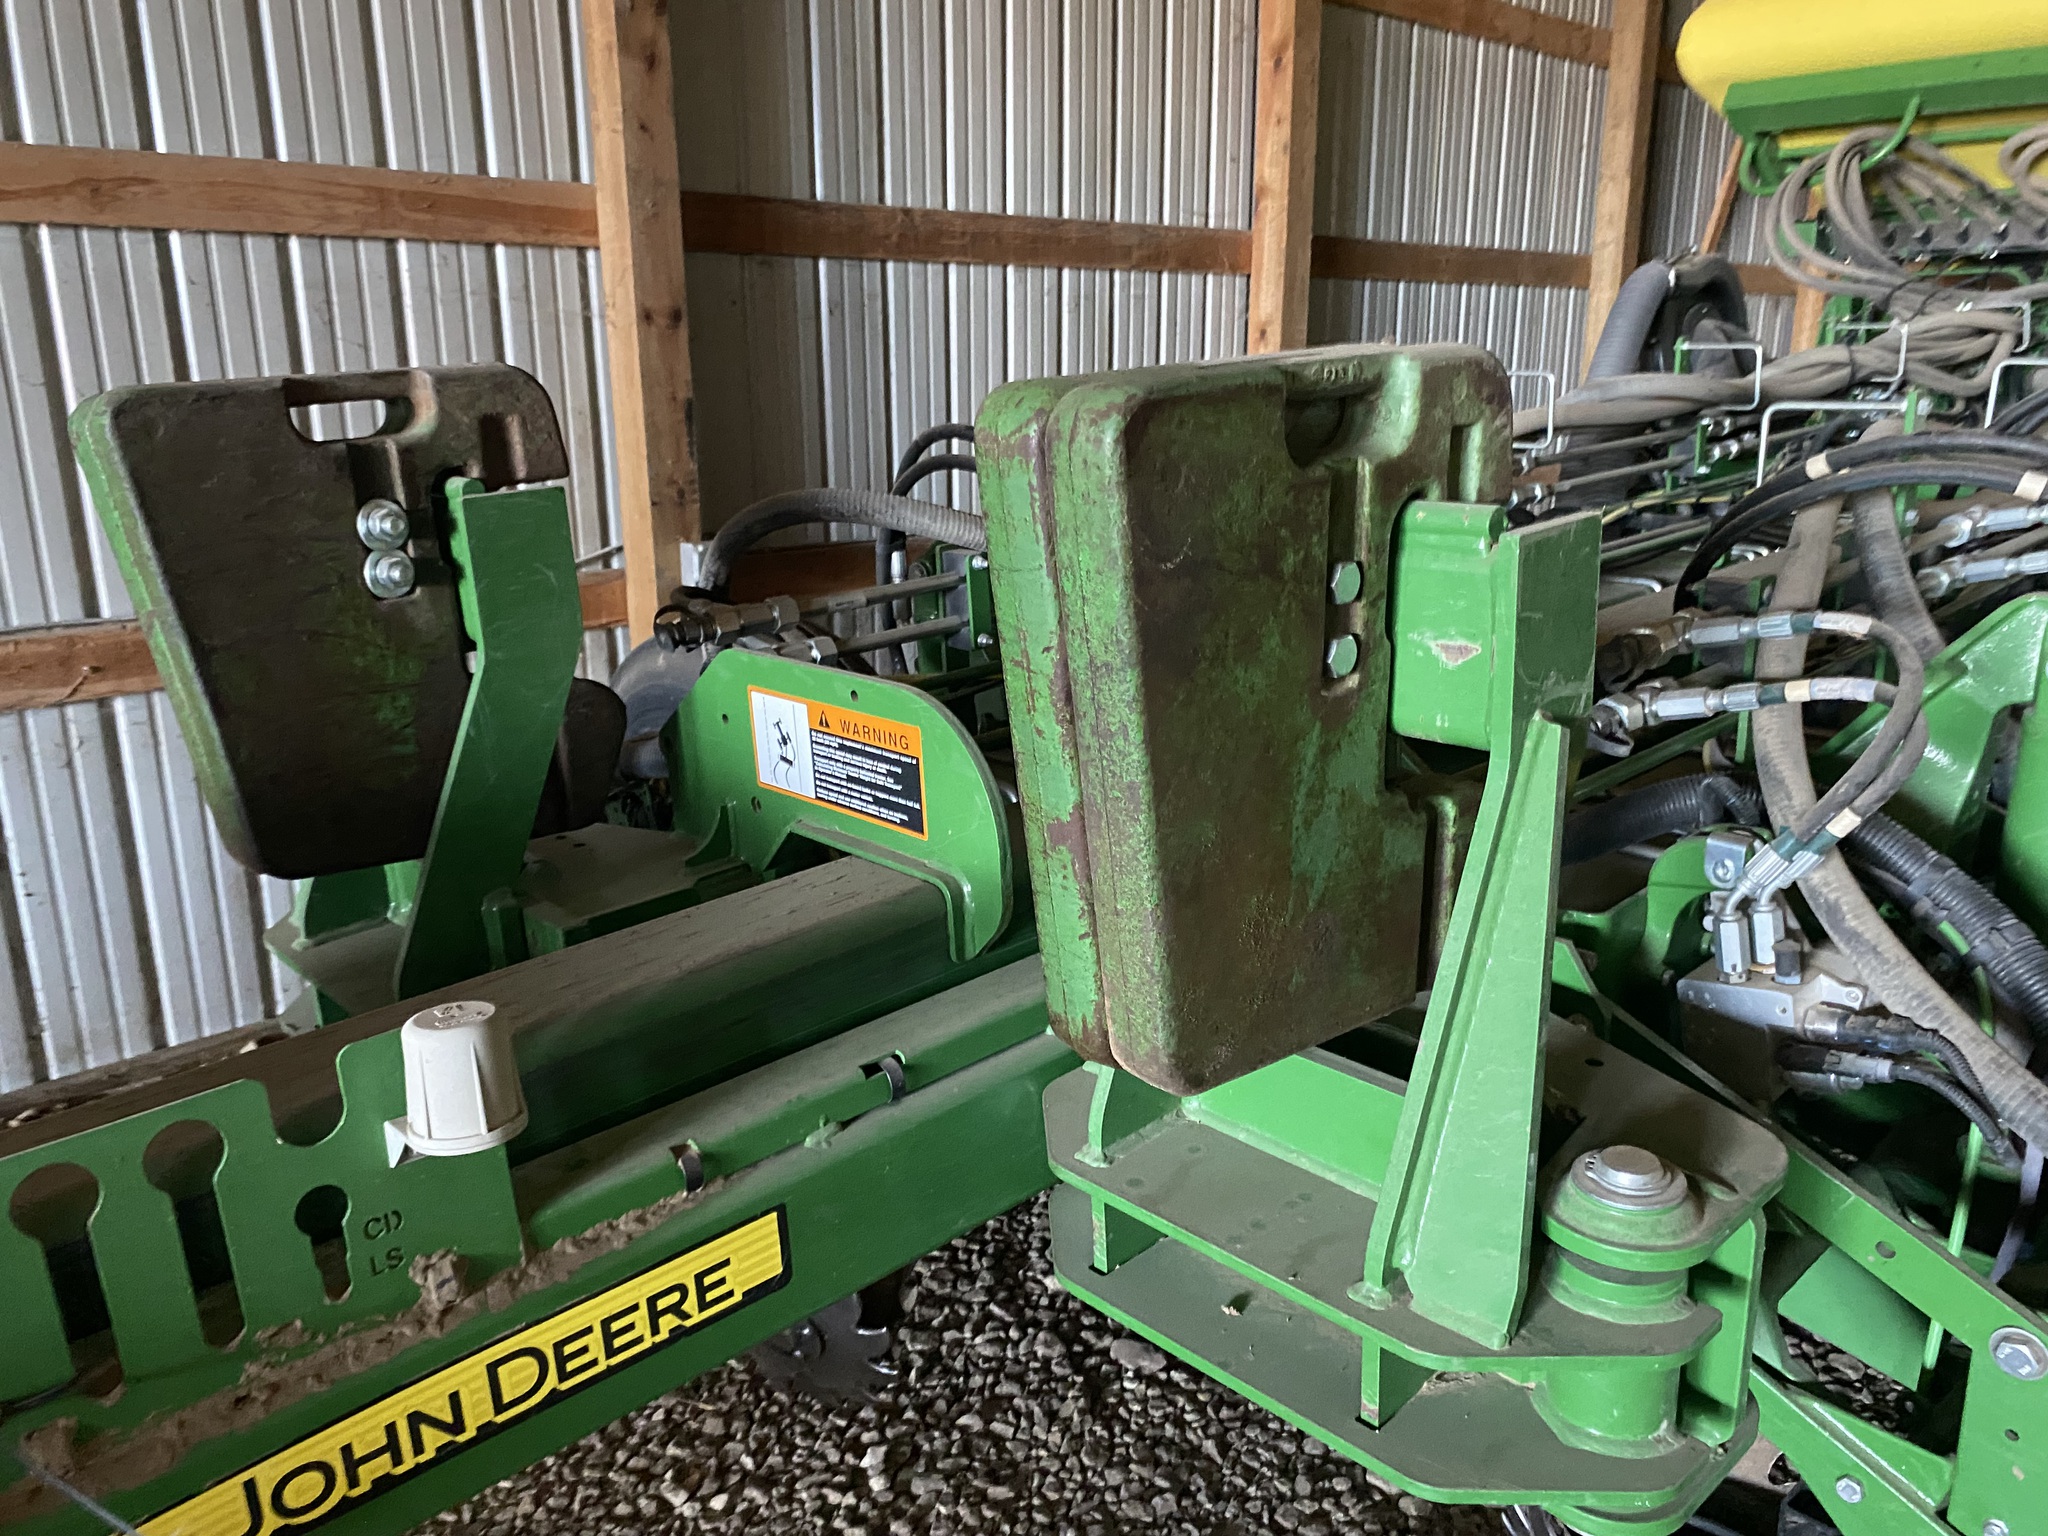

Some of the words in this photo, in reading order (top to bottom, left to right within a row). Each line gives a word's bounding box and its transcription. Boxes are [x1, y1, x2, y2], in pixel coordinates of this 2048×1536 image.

[841, 719, 909, 750] WARNING
[370, 1247, 404, 1276] LS
[240, 1390, 467, 1536] JOHN
[486, 1257, 736, 1418] DEERE
